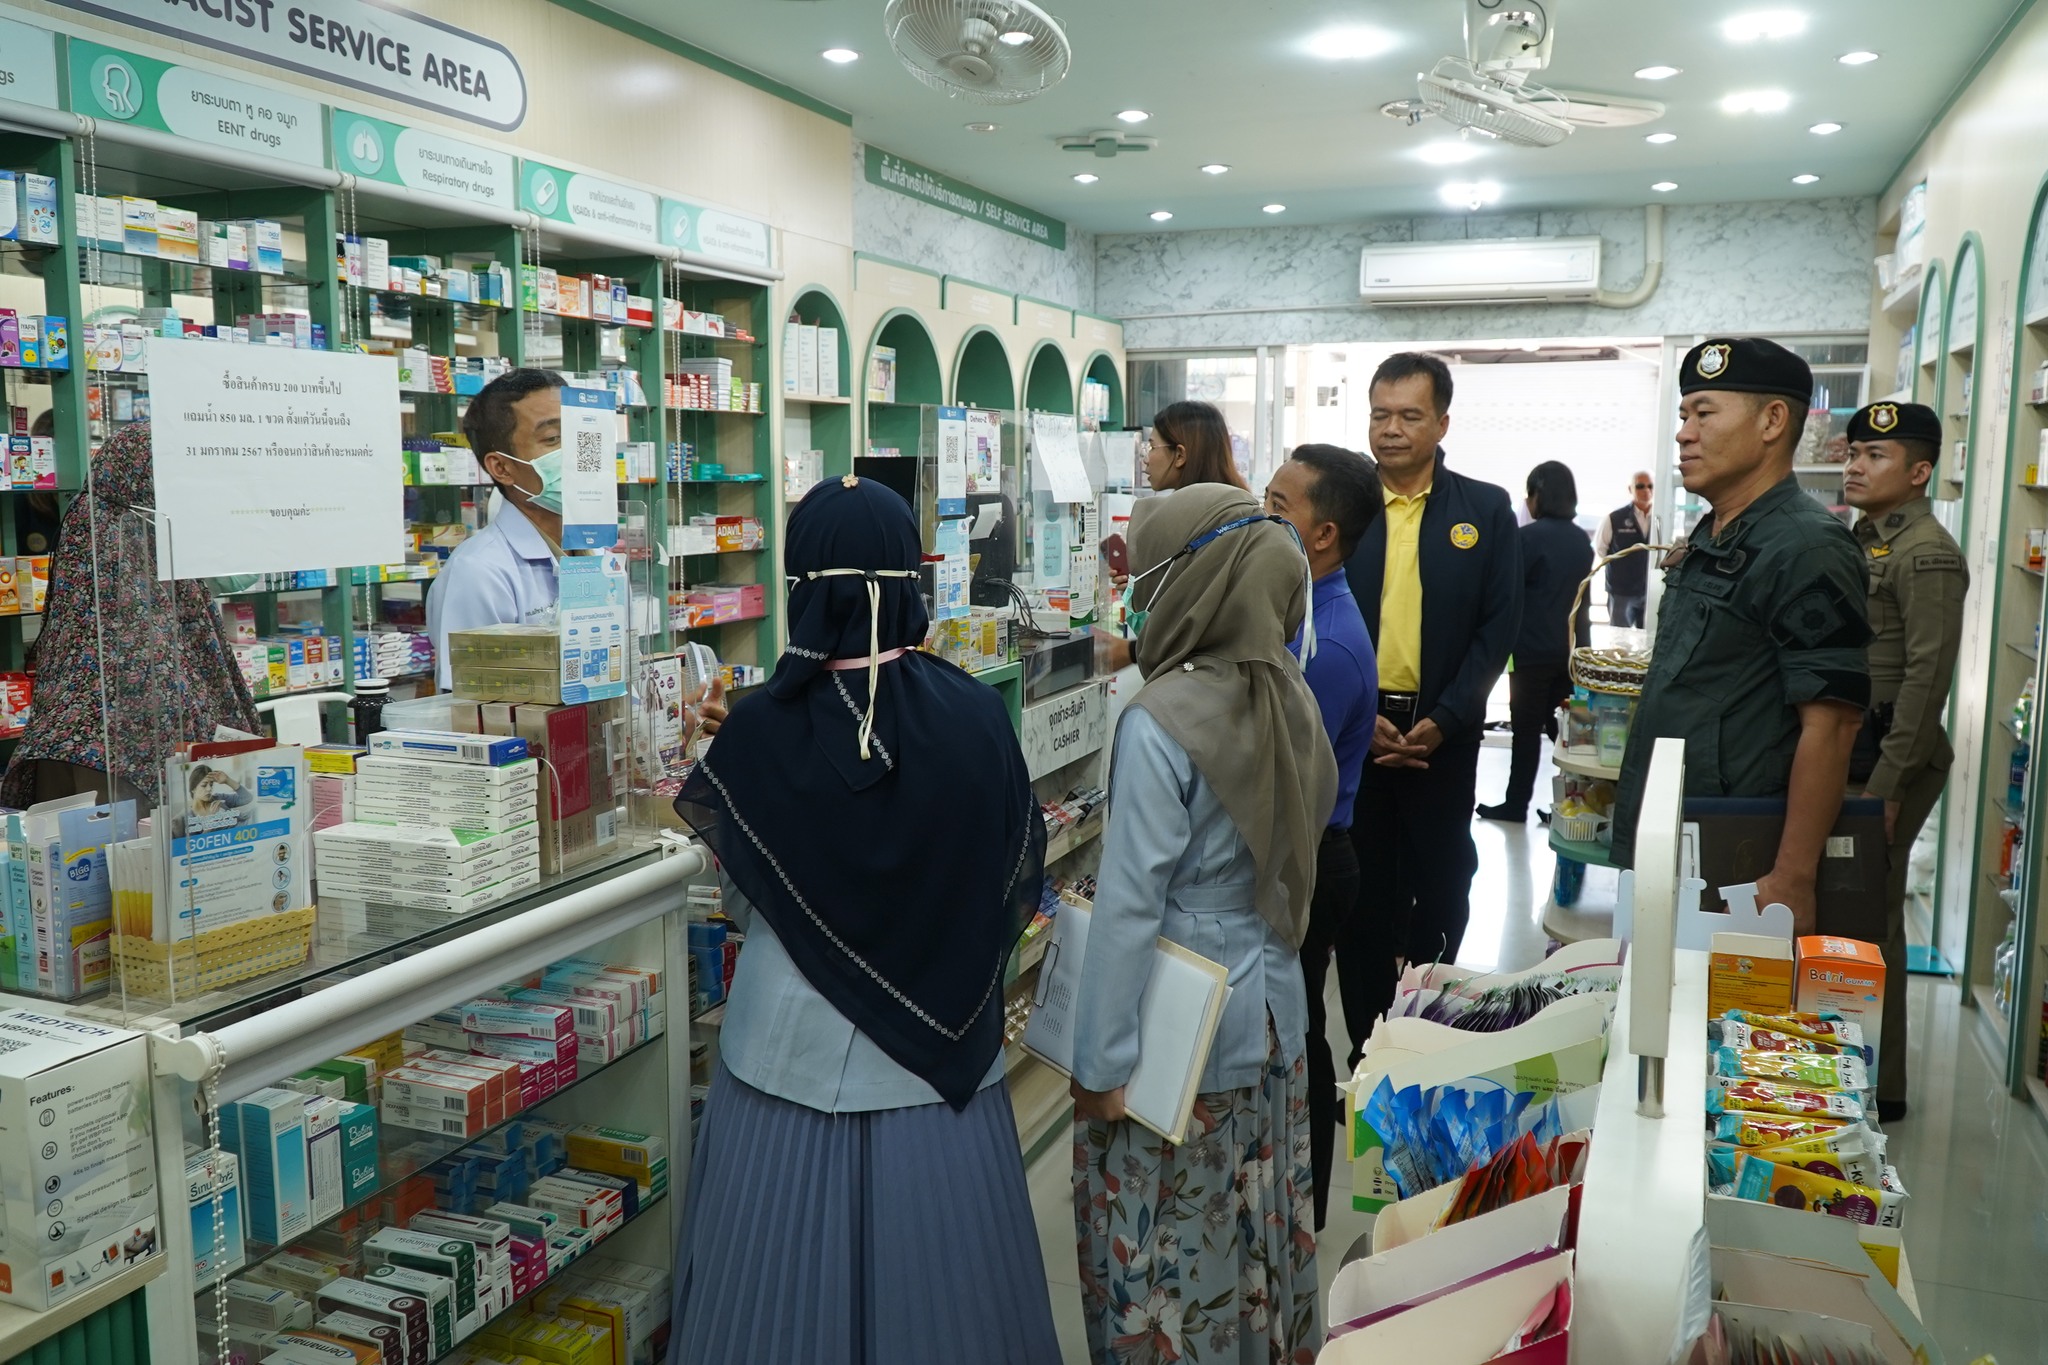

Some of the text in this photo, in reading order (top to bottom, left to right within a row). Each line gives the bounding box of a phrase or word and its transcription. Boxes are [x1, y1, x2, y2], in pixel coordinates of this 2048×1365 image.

[288, 7, 412, 77] SERVICE
[422, 52, 492, 102] AREA
[217, 119, 282, 149] EENT drugs
[422, 168, 495, 198] Respiratory drugs
[985, 202, 1003, 222] SELF
[1003, 209, 1031, 234] SERVICE
[1031, 222, 1049, 240] AREA
[283, 383, 298, 393] 200
[220, 413, 237, 424] 850
[186, 446, 197, 457] 31
[242, 446, 262, 457] 2567
[1053, 728, 1080, 752] CASHIER
[186, 827, 258, 852] GOFEN 400
[69, 864, 91, 878] BIGG
[1845, 978, 1877, 987] GUMMY
[9, 1012, 114, 1037] MEDTECH
[30, 1085, 76, 1107] Features:
[310, 1115, 319, 1123] 3M
[310, 1117, 336, 1134] Cavilon
[287, 1337, 348, 1357] Dermaman
